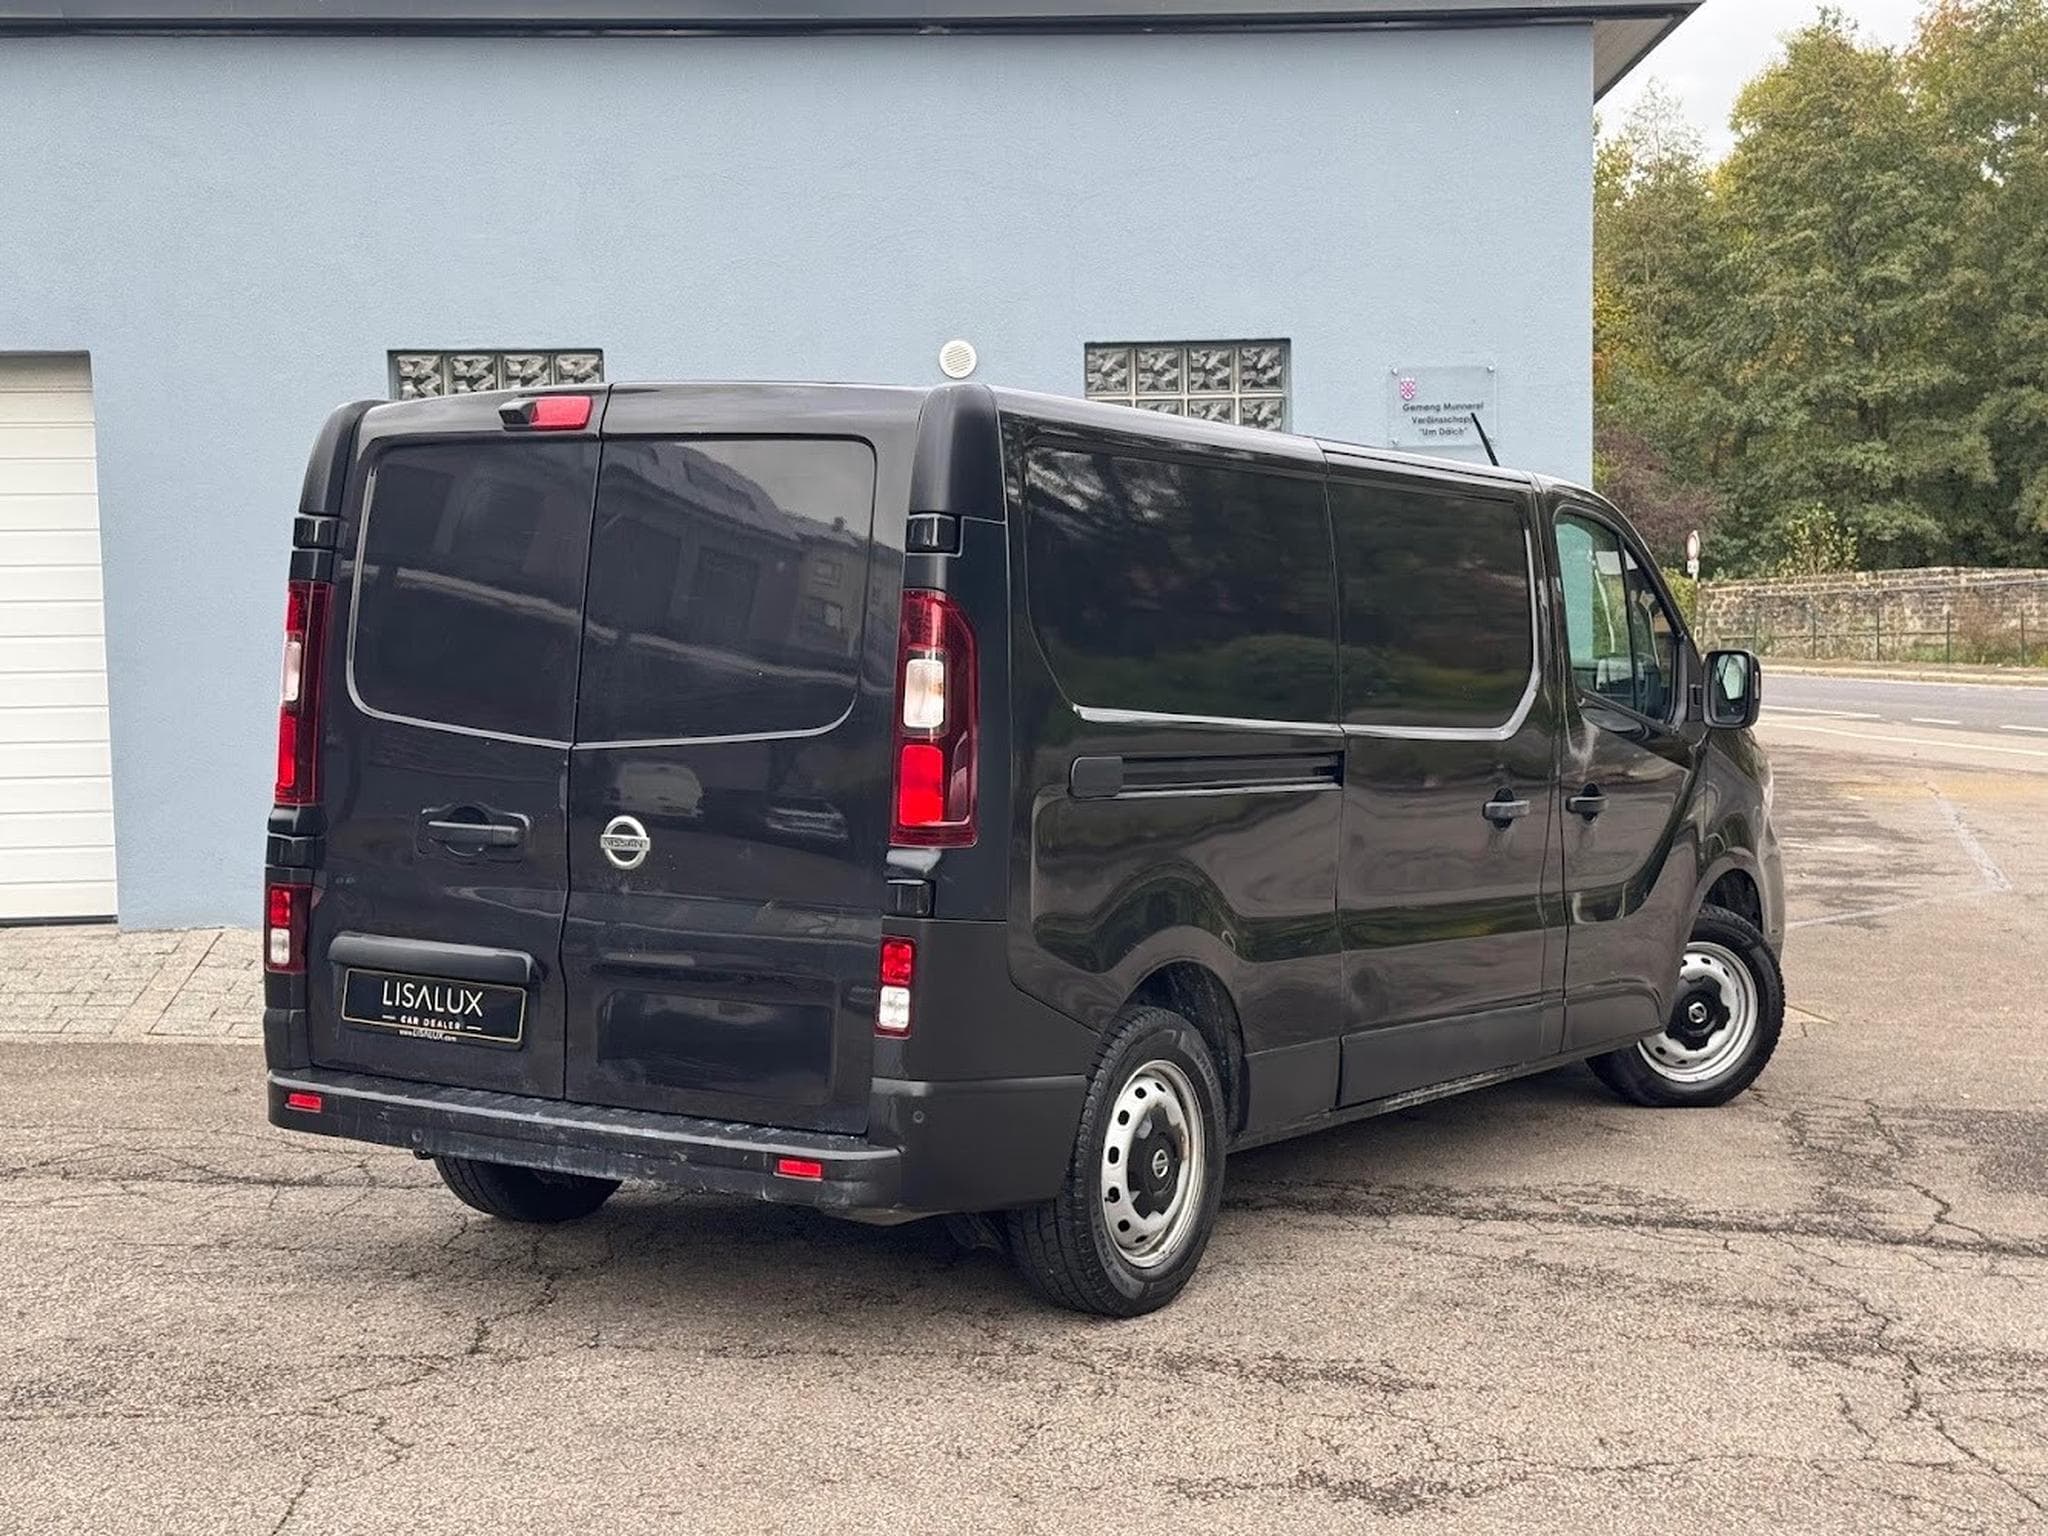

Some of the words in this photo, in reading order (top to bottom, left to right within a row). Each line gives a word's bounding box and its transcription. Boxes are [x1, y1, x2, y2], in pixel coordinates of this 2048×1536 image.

[1402, 403, 1441, 412] Gemeng
[604, 838, 643, 848] NISSAN
[382, 980, 484, 1017] LISALUX
[400, 1015, 419, 1025] CAR
[423, 1018, 461, 1030] DEALER
